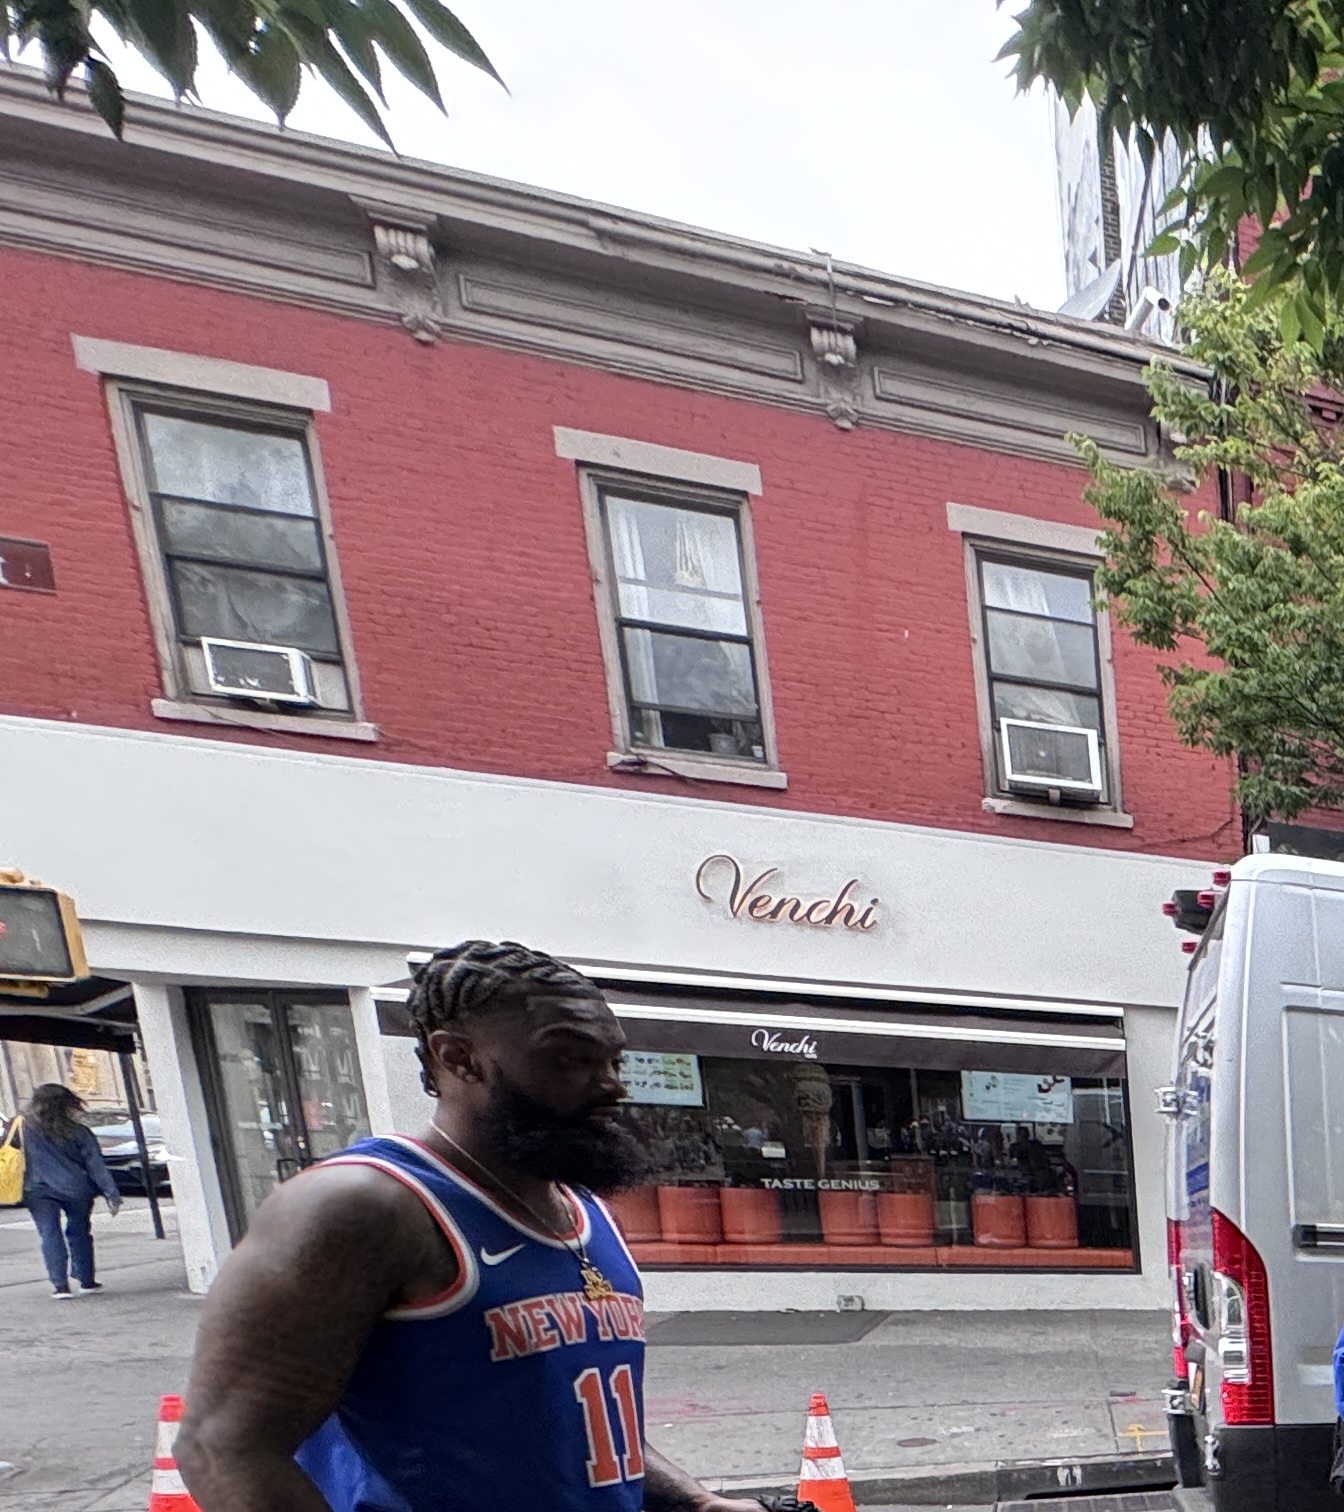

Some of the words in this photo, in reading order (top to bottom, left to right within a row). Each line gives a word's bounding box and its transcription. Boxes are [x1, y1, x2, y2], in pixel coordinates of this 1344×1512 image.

[696, 854, 879, 930] Venchi
[751, 1028, 818, 1054] Venchi
[760, 1177, 815, 1191] TASTE
[816, 1178, 881, 1192] GENIUS
[484, 1291, 587, 1363] NEW
[581, 1291, 646, 1343] YOR
[573, 1363, 645, 1489] 11
